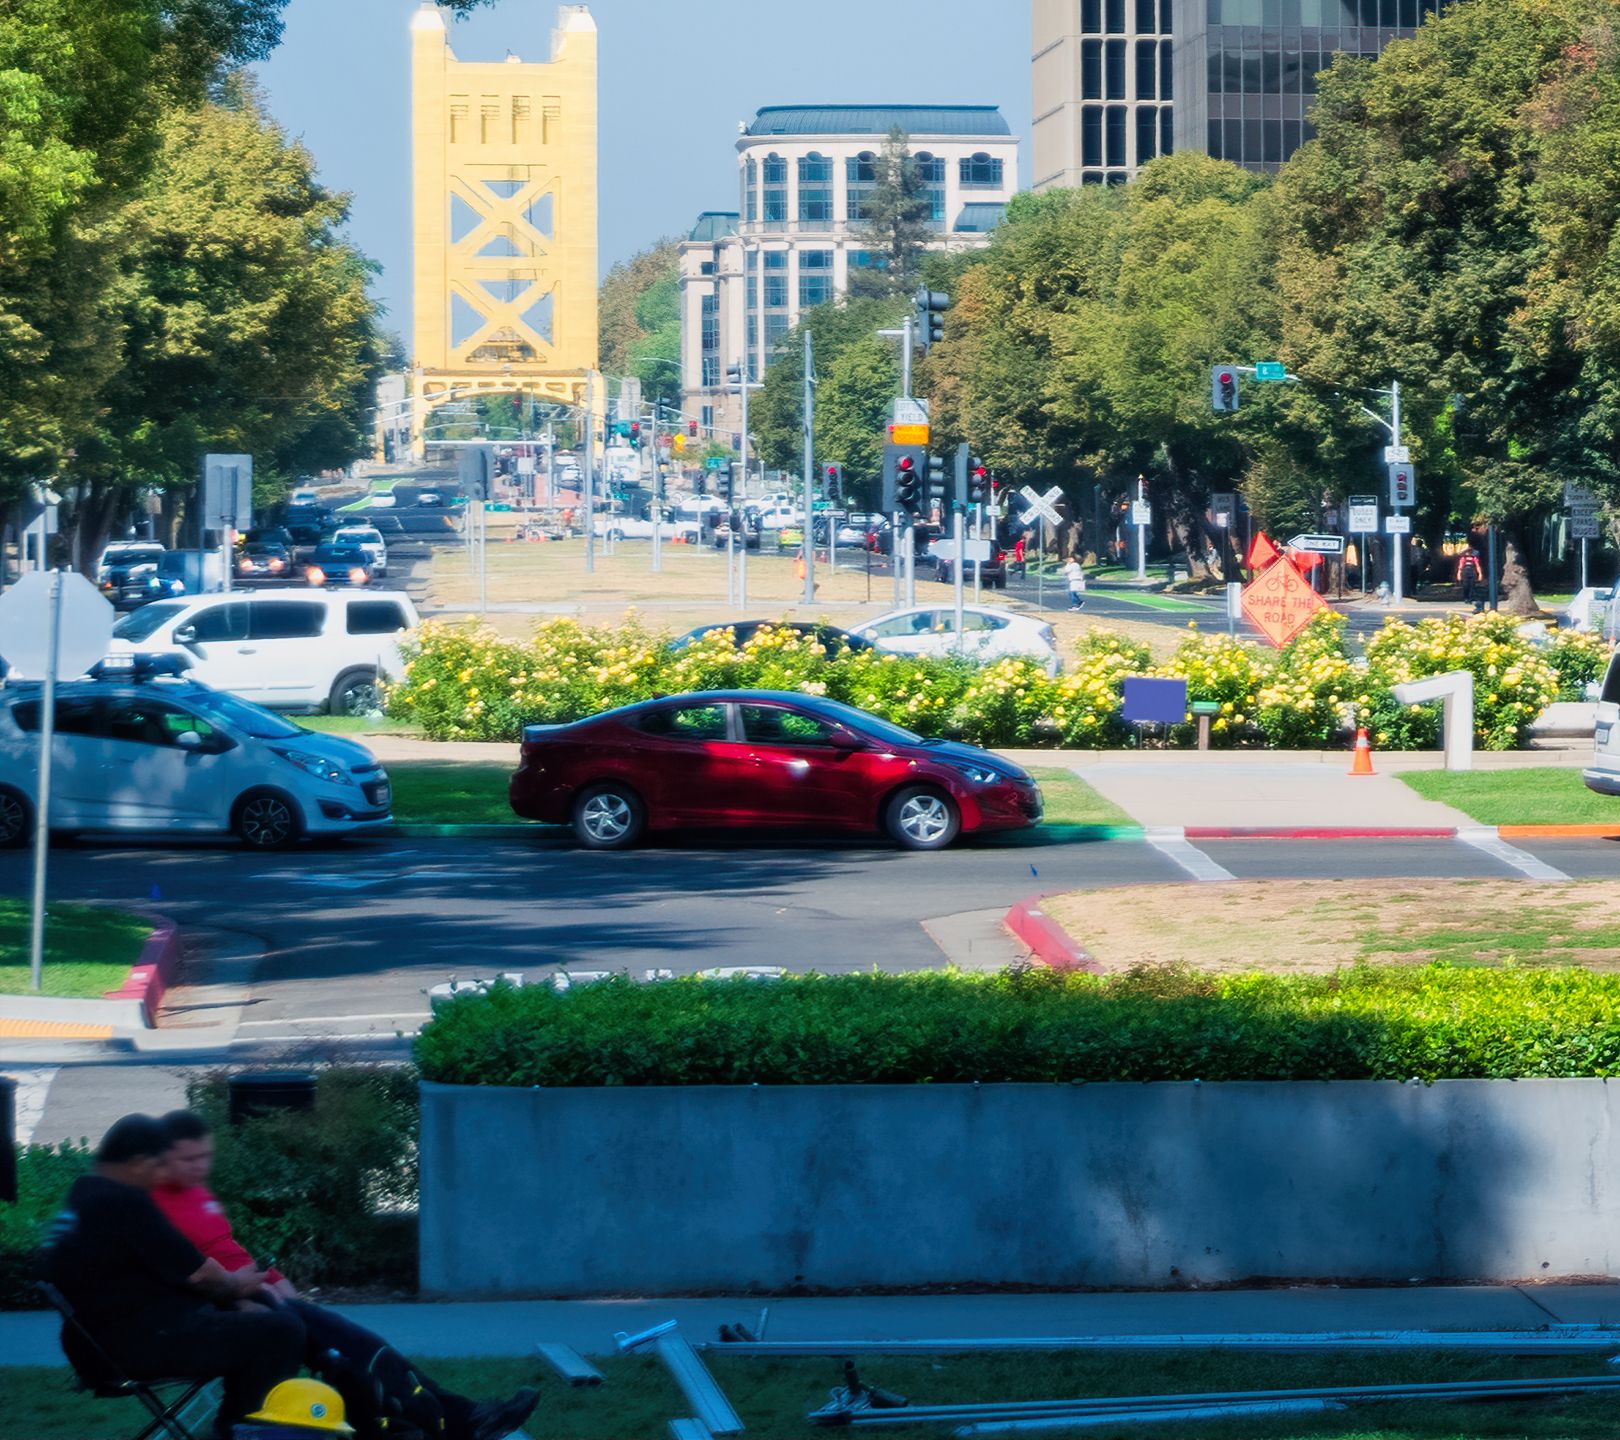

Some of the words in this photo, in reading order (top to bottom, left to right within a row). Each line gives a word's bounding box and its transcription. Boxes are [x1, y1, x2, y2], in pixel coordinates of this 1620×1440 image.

[1248, 594, 1287, 608] SHARE
[1292, 597, 1313, 609] THE
[1264, 611, 1296, 624] ROAD
